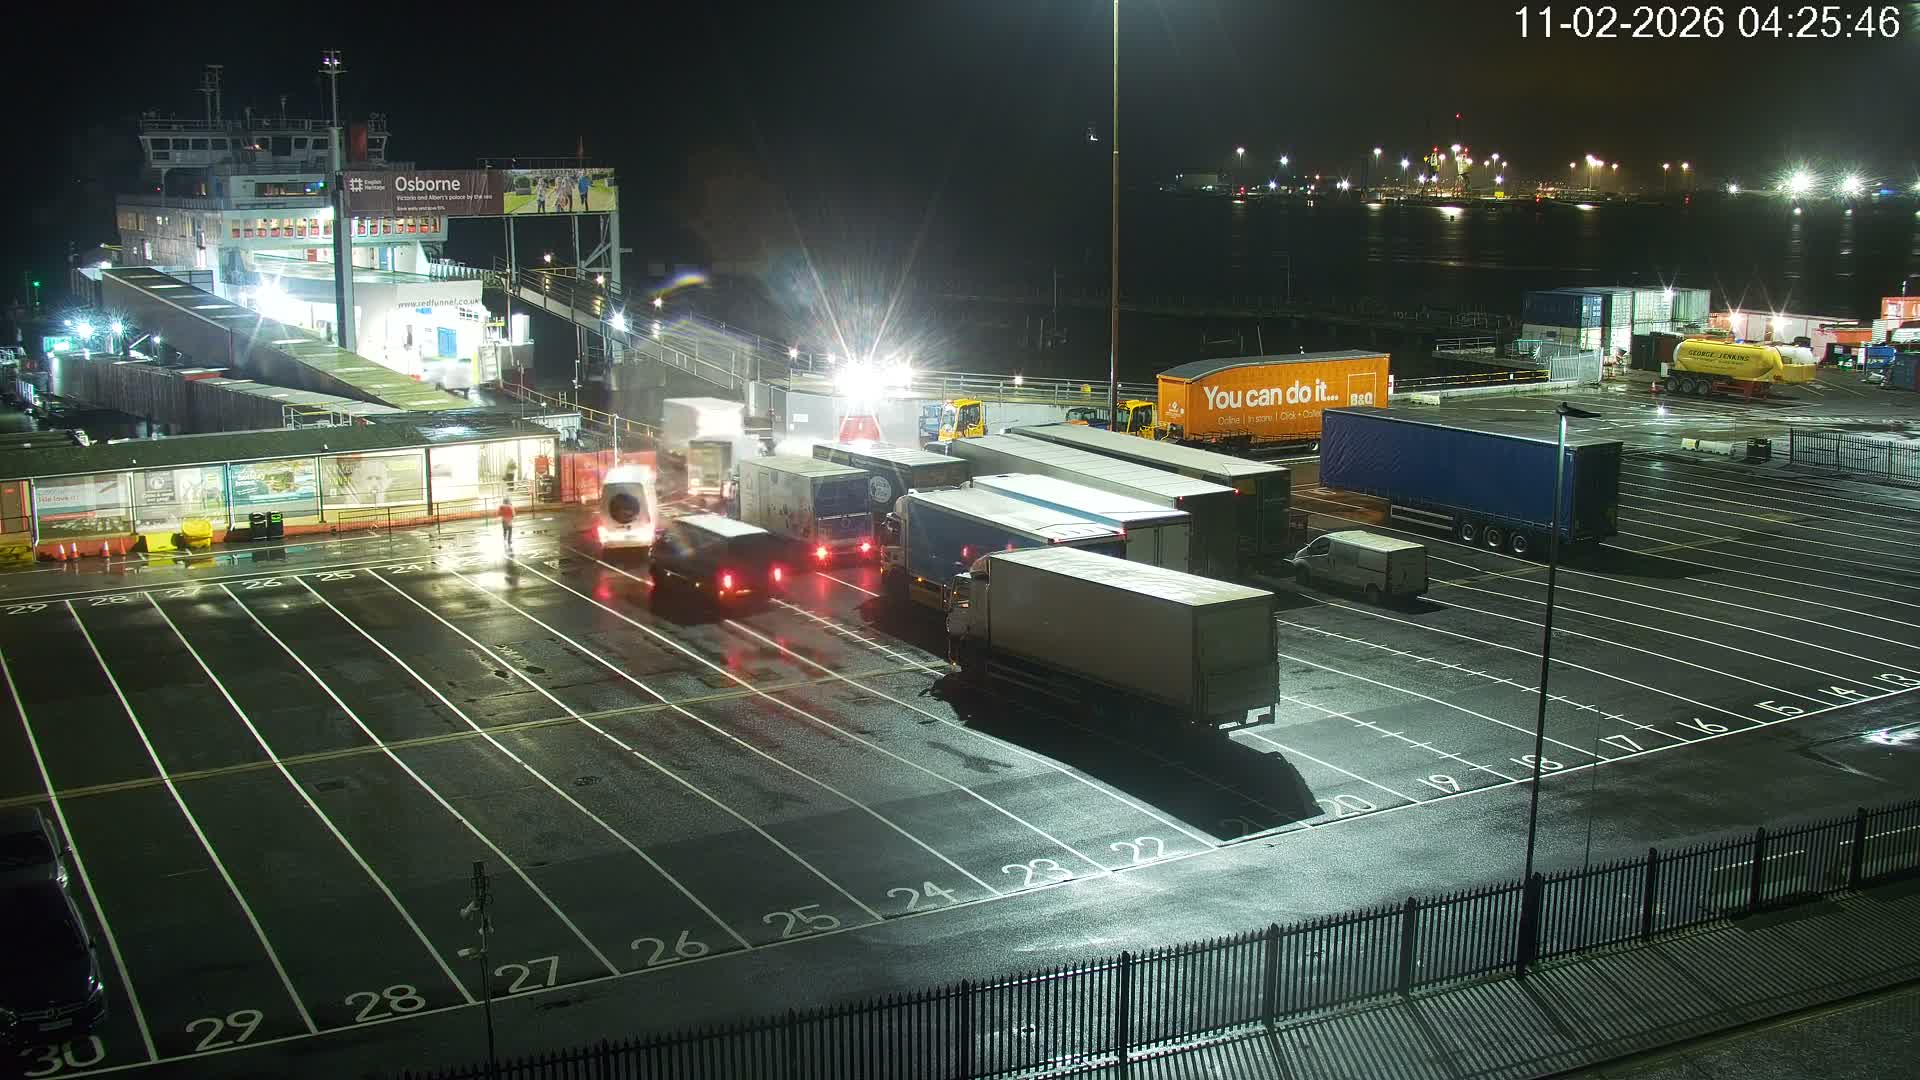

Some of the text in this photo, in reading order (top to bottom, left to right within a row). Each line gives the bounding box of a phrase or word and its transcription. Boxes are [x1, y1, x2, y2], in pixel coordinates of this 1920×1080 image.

[395, 176, 461, 192] Osborne
[398, 298, 480, 308] www.redfunnel.co.uk
[1688, 349, 1715, 358] GEORGE
[1717, 351, 1750, 362] JENKINS
[1203, 378, 1340, 410] You can do it...
[1350, 391, 1373, 406] B&Q
[1217, 415, 1240, 426] Online
[1279, 411, 1297, 421] Click
[315, 570, 356, 582] 25
[387, 563, 424, 574] 24
[166, 586, 202, 598] 27
[241, 578, 283, 590] 26
[6, 602, 48, 615] 29
[88, 595, 129, 607] 28
[1818, 685, 1871, 701] 14
[1754, 700, 1804, 717] 15
[1675, 717, 1729, 735] 16
[1600, 734, 1645, 753] 17
[1510, 754, 1563, 773] 18
[1416, 774, 1461, 793] 19
[1317, 794, 1377, 818] 20
[1110, 836, 1182, 864] 22
[1001, 858, 1073, 886] 23
[886, 881, 954, 912] 24
[762, 904, 841, 937] 25
[631, 930, 709, 967] 26
[493, 955, 559, 993] 27
[345, 983, 426, 1022] 28
[185, 1009, 264, 1052] 29
[18, 1034, 105, 1077] 30
